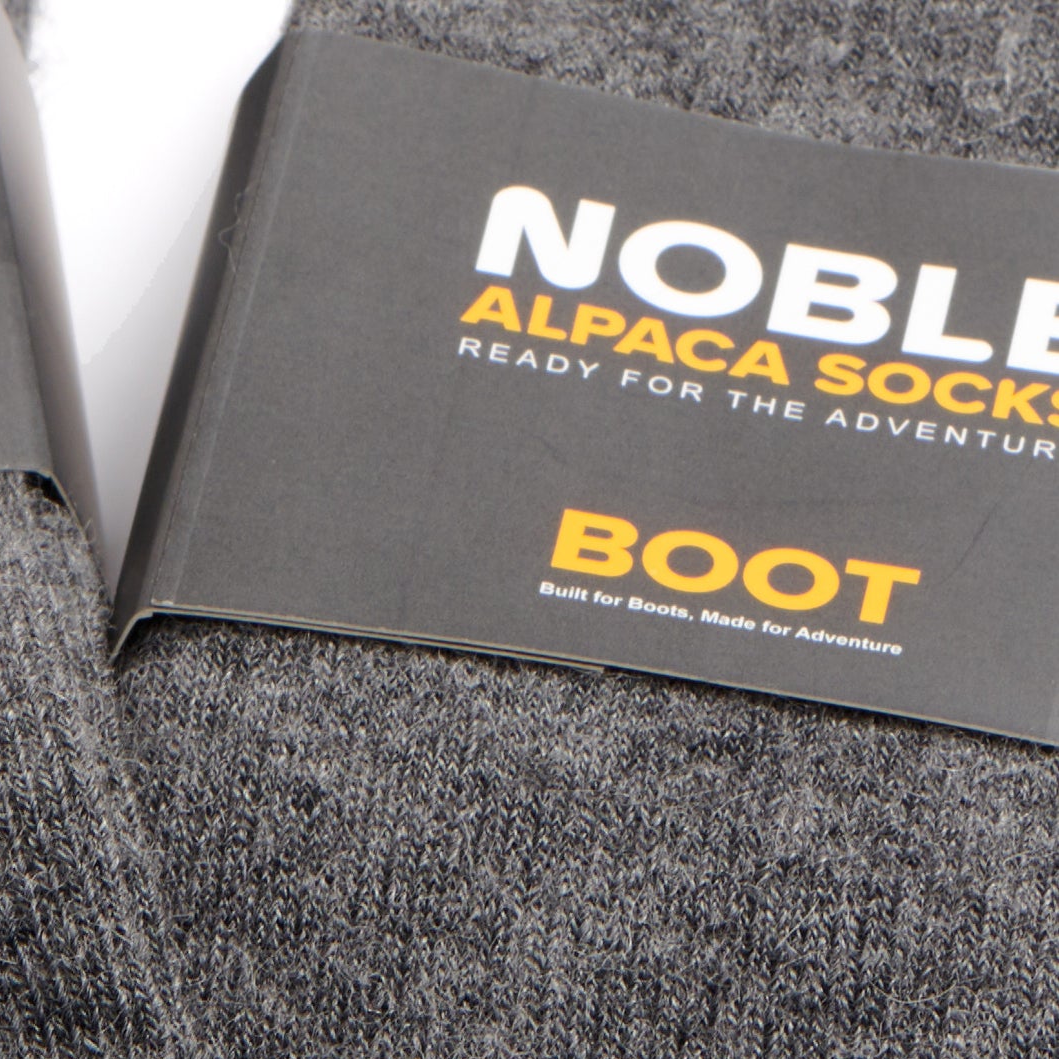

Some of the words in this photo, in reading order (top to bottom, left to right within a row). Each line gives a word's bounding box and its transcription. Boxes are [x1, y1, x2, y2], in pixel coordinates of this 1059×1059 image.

[458, 336, 600, 380] READY
[621, 368, 704, 402] FOR
[728, 390, 806, 420] THE
[460, 285, 790, 386] ALPACA
[813, 353, 1059, 428] SOCK
[550, 508, 922, 625] BOOT
[538, 581, 589, 602] Built
[593, 592, 624, 607] for
[627, 596, 694, 621] Boots,
[700, 609, 756, 631] Made
[762, 619, 792, 637] for
[794, 626, 903, 656] Adventure
